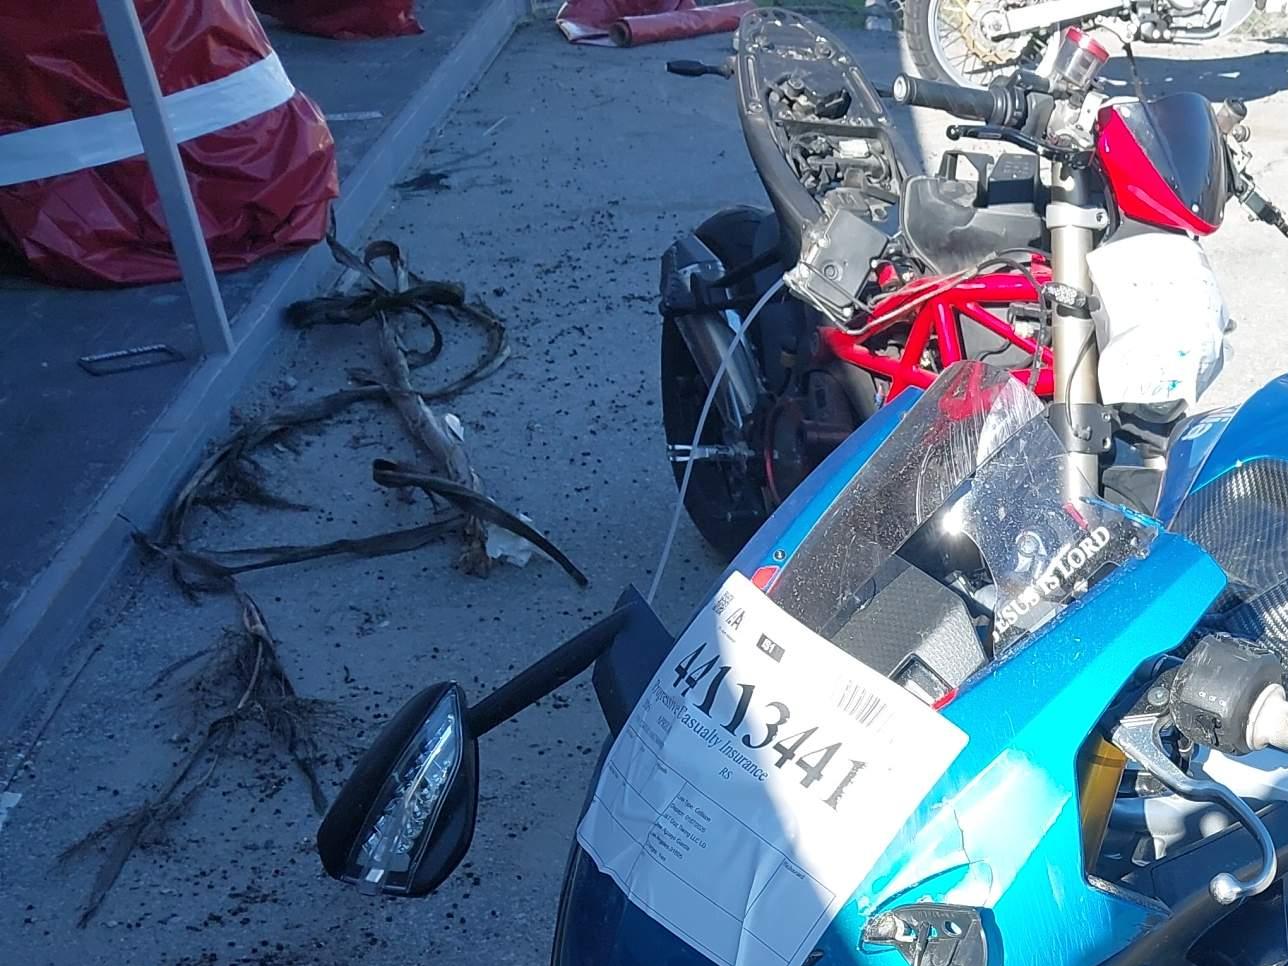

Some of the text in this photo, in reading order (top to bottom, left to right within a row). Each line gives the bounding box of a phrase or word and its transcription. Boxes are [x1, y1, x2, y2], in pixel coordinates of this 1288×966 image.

[992, 585, 1040, 640] JESUS
[1060, 525, 1111, 581] LORD
[673, 642, 867, 811] 44113441
[676, 703, 723, 749] Casualty
[719, 740, 769, 782] Insurance
[718, 767, 733, 780] RS
